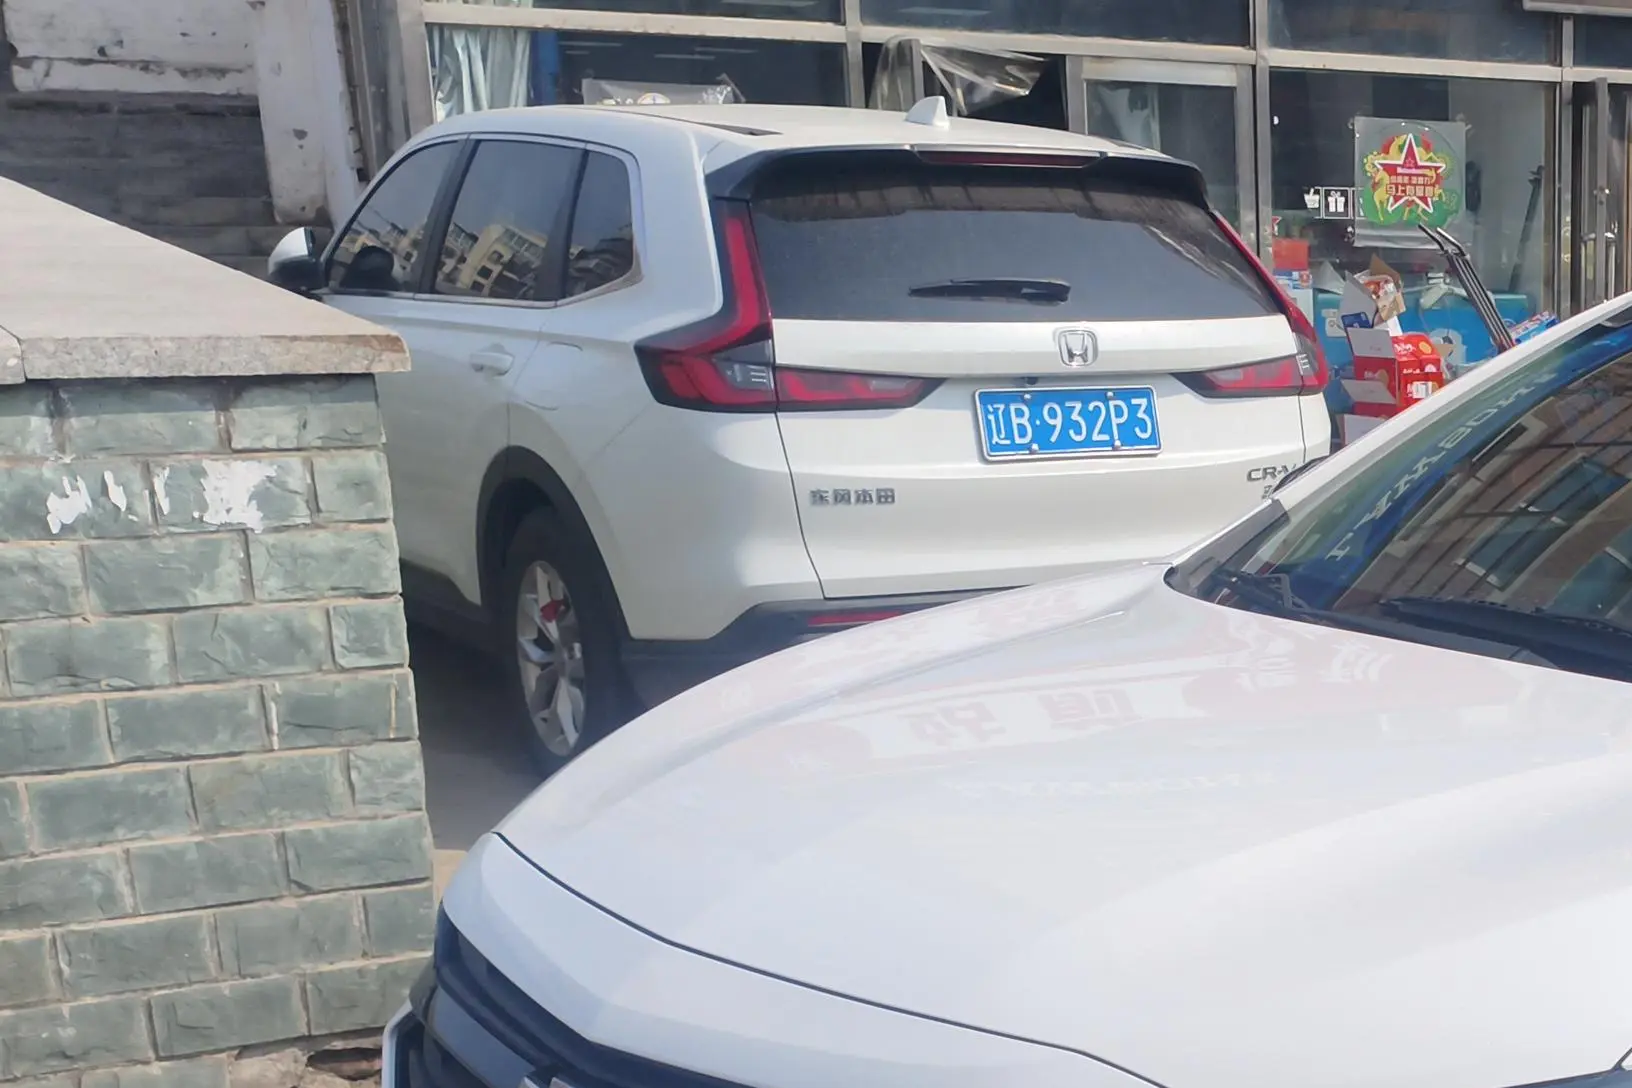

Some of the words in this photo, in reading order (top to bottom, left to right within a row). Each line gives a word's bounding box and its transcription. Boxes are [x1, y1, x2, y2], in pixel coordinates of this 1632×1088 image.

[987, 398, 1152, 445] 辽B·932P3
[809, 488, 896, 506] 东风本田
